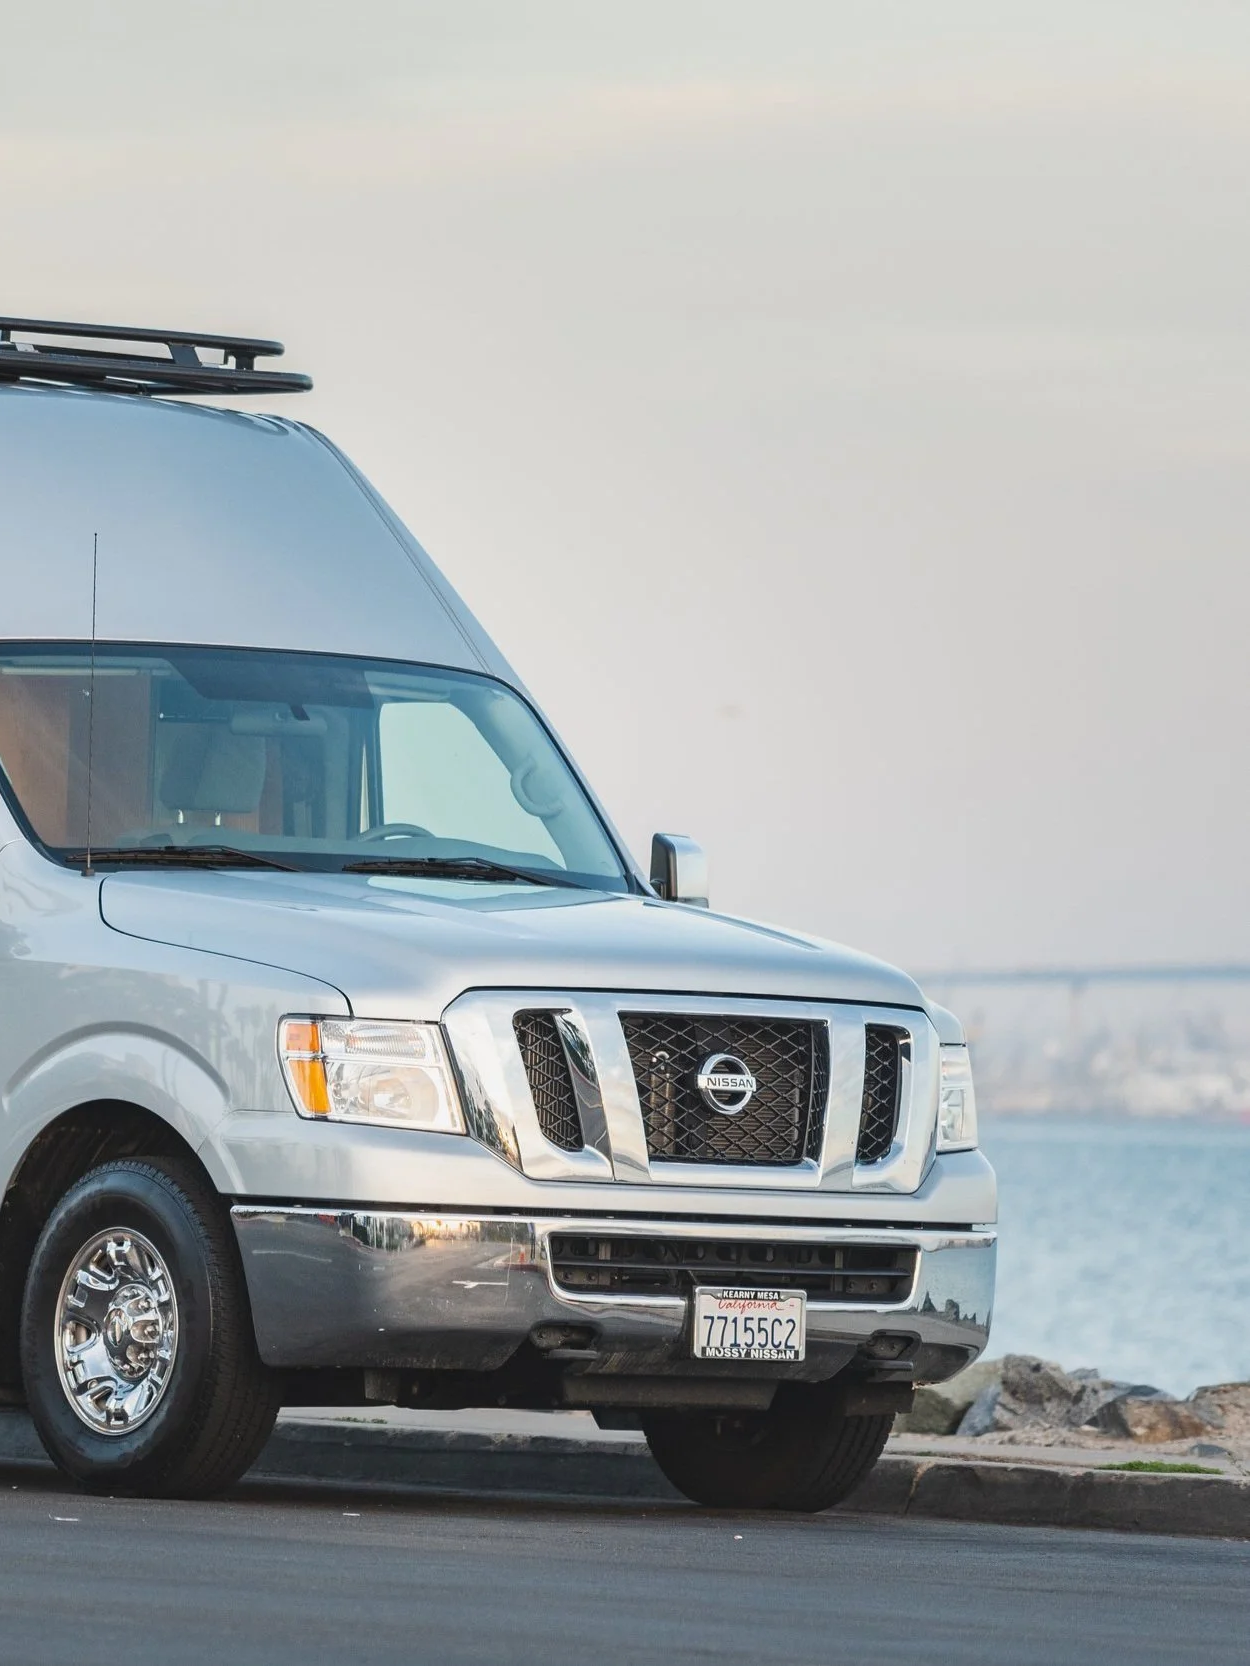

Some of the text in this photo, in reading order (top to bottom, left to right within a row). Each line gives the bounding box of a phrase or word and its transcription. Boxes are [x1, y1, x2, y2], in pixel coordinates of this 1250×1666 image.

[707, 1077, 753, 1089] NISSAN
[723, 1290, 779, 1300] KEARNY MESA
[718, 1299, 784, 1314] California
[703, 1315, 796, 1349] 77155C2
[705, 1347, 795, 1360] MOSSY NISSAN
